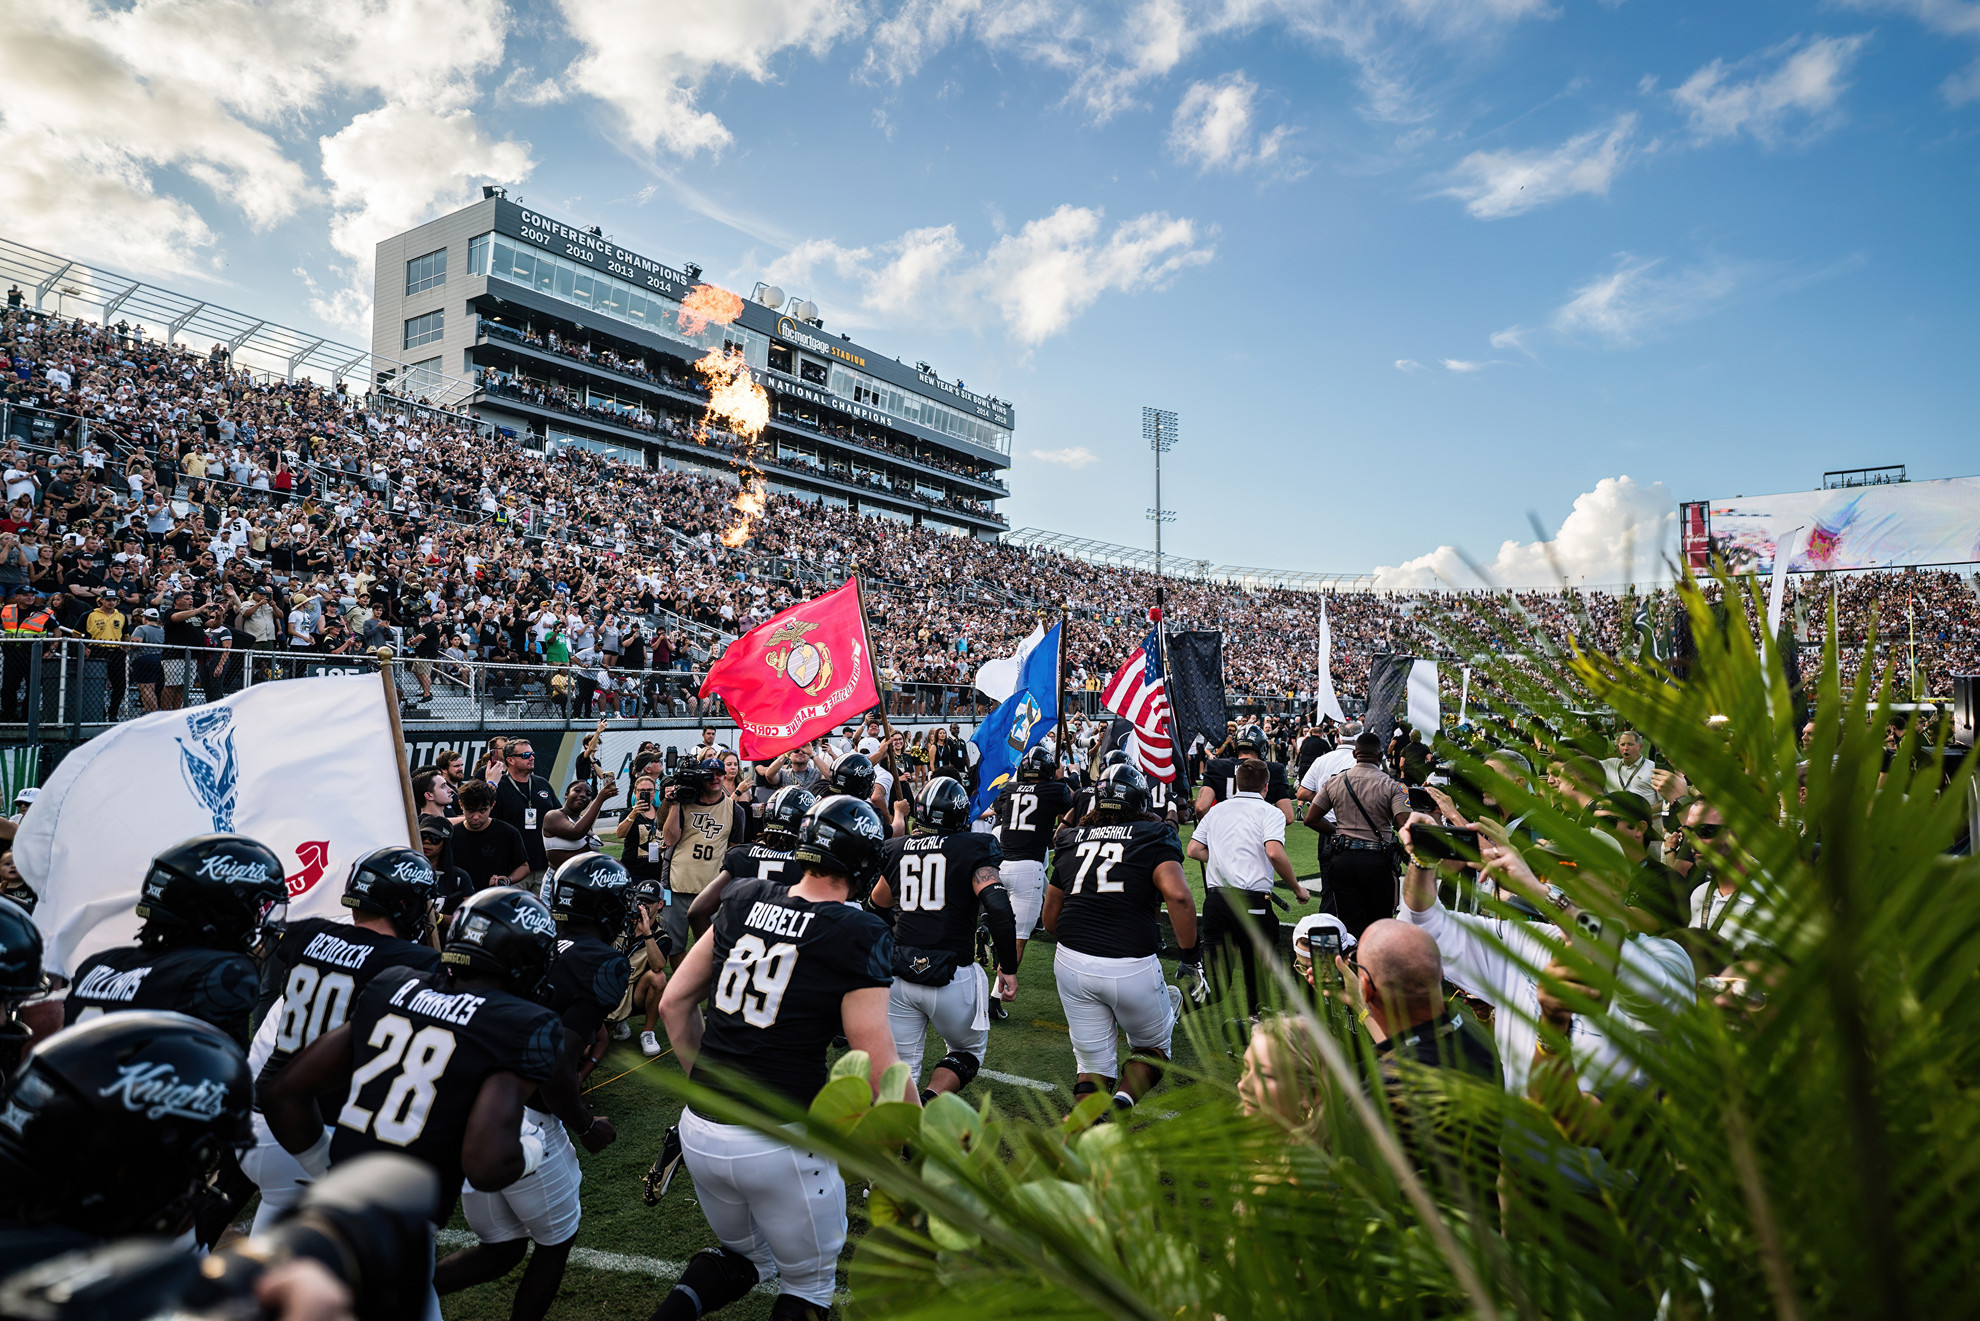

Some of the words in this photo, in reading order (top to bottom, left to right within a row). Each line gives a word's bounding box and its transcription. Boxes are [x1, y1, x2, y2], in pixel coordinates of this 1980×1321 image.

[520, 225, 551, 246] 2007
[565, 243, 594, 263] 2010
[607, 260, 634, 279] 2013
[646, 275, 672, 293] 2014
[521, 210, 613, 257] CONFERENCE
[616, 249, 688, 287] CHAMPIONS
[794, 330, 829, 355] mortgage
[831, 346, 865, 367] STADIUM
[768, 377, 827, 405] NATIONAL
[831, 399, 893, 427] CHAMPIONS
[919, 373, 935, 386] NEW
[936, 378, 960, 396] YEAR'S
[960, 389, 972, 401] SIX
[973, 395, 991, 409] BOWL
[991, 401, 1007, 416] WINS
[232, 522, 241, 531] 5
[1016, 783, 1037, 793] RICK
[691, 812, 725, 840] UCF
[1009, 793, 1039, 832] 12
[903, 835, 949, 851] METCALF
[1086, 825, 1133, 841] MARSHALL
[196, 855, 269, 885] Knights
[692, 844, 713, 861] 50
[1070, 841, 1125, 895] 72
[899, 852, 947, 912] 60
[463, 926, 487, 944] XII
[744, 901, 816, 938] RUBELT
[303, 932, 375, 969] REDDICK
[75, 964, 153, 1002] WILLIAMS
[715, 933, 799, 1029] 89
[276, 963, 356, 1054] 80
[98, 1061, 231, 1122] Knights
[337, 1012, 457, 1148] 28
